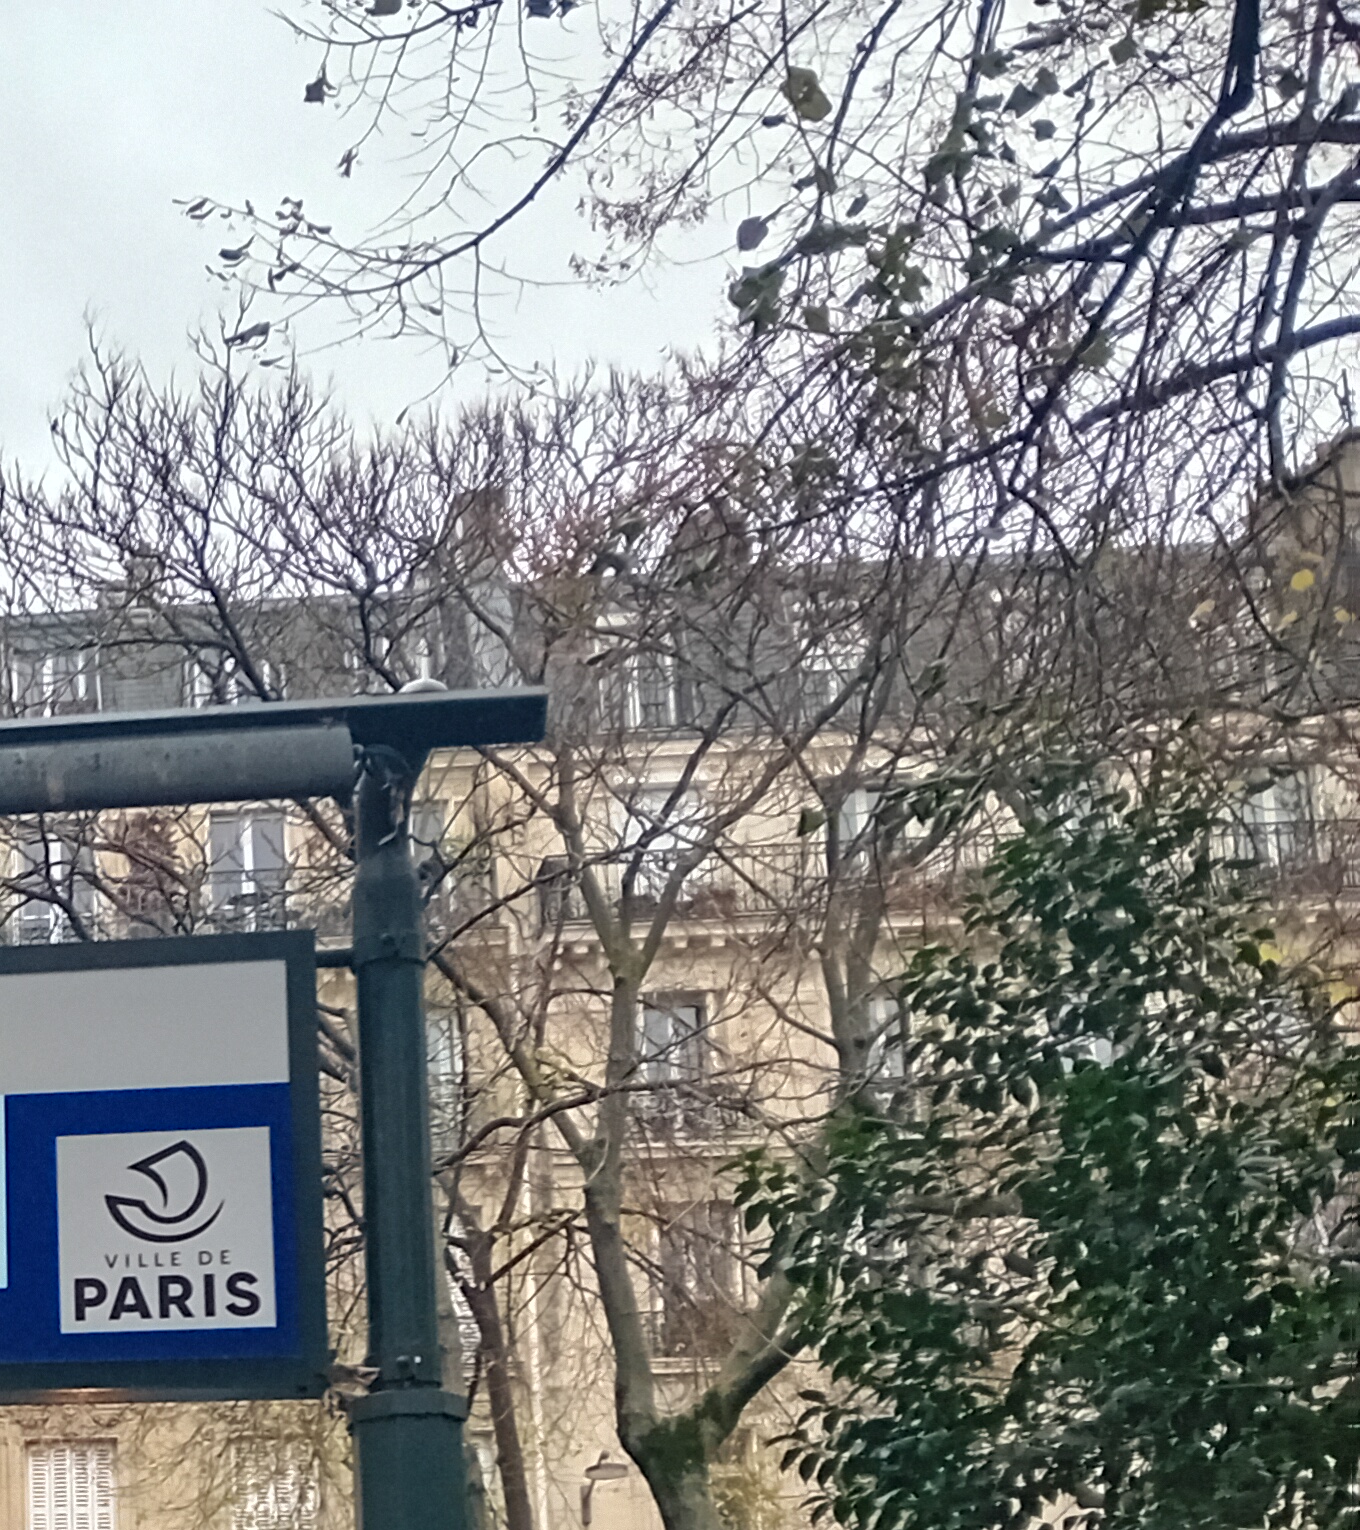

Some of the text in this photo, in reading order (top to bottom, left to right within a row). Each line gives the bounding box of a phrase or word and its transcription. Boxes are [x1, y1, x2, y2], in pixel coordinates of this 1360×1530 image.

[104, 1249, 232, 1269] VILLE DE
[74, 1271, 262, 1322] PARIS
